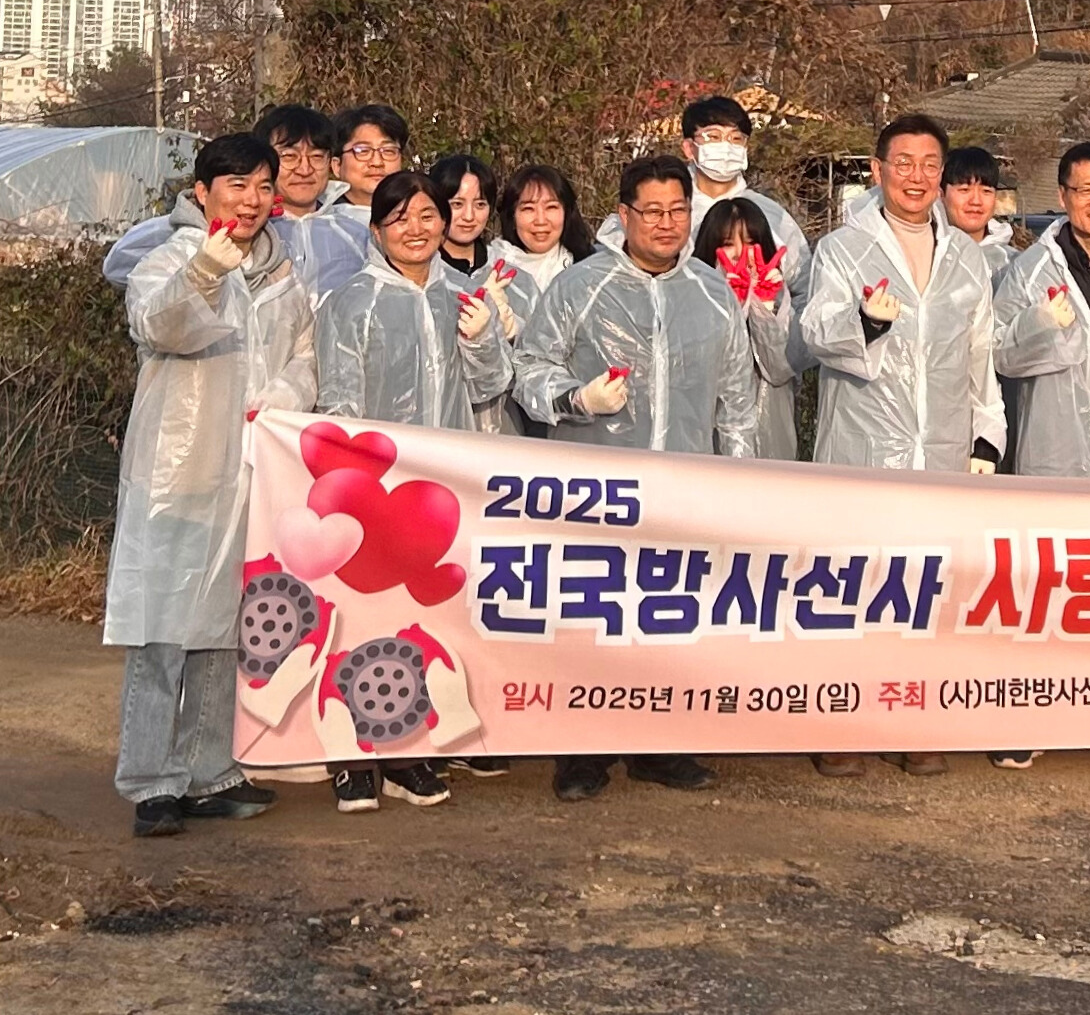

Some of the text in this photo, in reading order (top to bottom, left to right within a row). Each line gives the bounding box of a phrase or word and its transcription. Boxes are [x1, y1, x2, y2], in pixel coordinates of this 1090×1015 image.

[483, 474, 641, 527] 2025
[476, 543, 944, 637] 전국방사선사
[501, 681, 554, 712] 일시
[567, 684, 674, 714] 2025년
[682, 684, 740, 715] 11월
[745, 683, 809, 715] 30일
[816, 681, 861, 715] (일)
[877, 679, 927, 712] 주최
